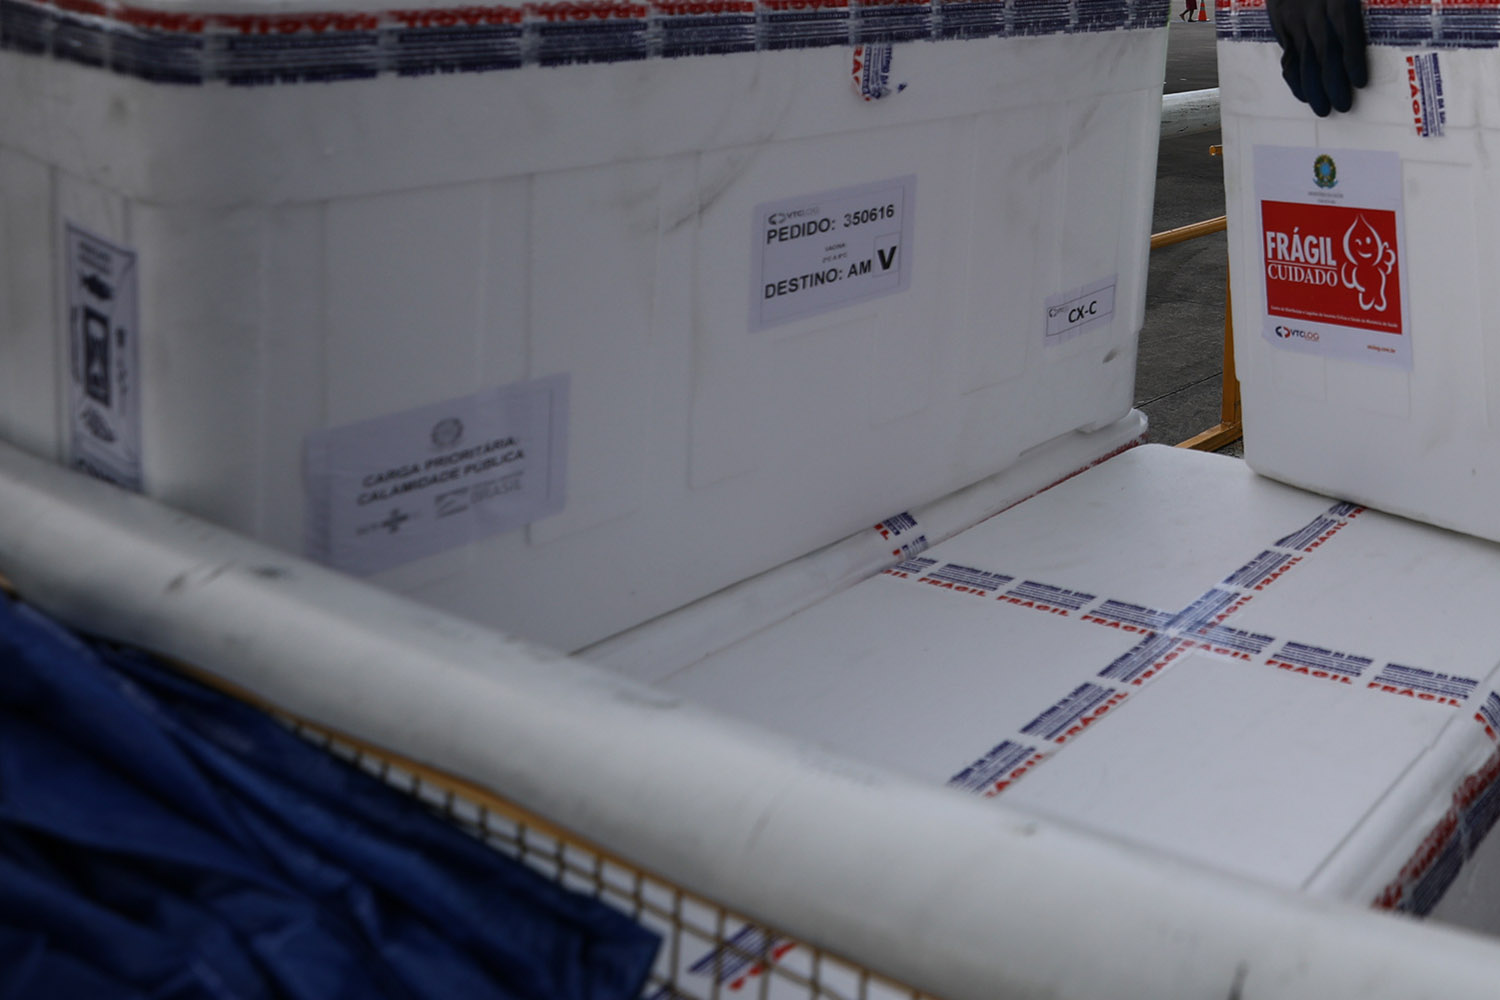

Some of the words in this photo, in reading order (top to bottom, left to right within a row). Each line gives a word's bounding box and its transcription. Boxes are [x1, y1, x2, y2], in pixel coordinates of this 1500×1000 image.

[766, 218, 836, 245] PEDIDO:
[843, 204, 894, 228] 350616
[877, 245, 897, 271] V
[1266, 227, 1337, 266] FRÁGIL
[764, 268, 843, 299] DESTINO:
[847, 259, 872, 278] AM
[1267, 264, 1338, 287] CUIDADO
[1068, 300, 1097, 323] CX-C
[357, 465, 460, 506] CALAMIDADE
[463, 448, 525, 476] PÚBLICA
[362, 464, 420, 488] CARGA
